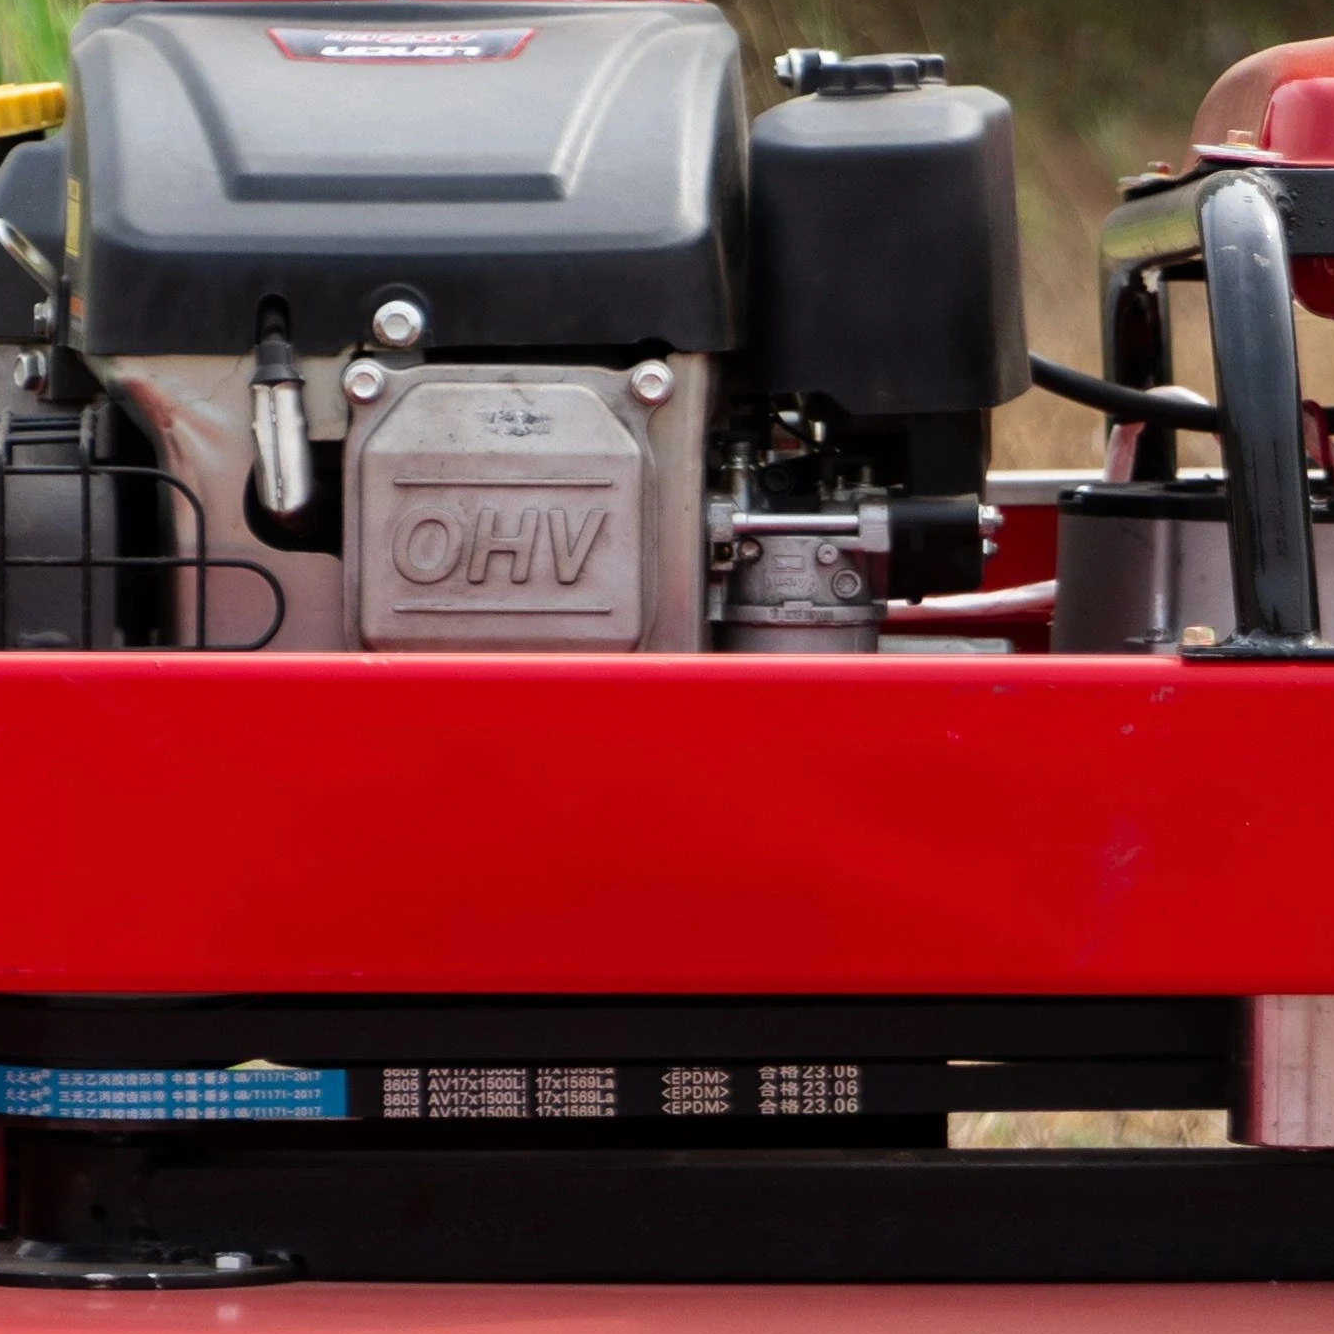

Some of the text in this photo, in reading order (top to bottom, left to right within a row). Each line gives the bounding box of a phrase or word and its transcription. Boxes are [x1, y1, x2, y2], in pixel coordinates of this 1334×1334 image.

[392, 506, 607, 585] OHV
[233, 1070, 322, 1084] GB/T1171-2017
[383, 1070, 730, 1092] 8605 AV17x1500Li 17x1569La <EPDM>
[233, 1088, 323, 1101] GB/T1171-2017
[383, 1085, 730, 1106] 8605 AV17x1500Li 17x1569La <EPDM>
[383, 1107, 420, 1118] 8605
[535, 1105, 616, 1117] 17x1569La
[660, 1100, 730, 1115] <EPDM>
